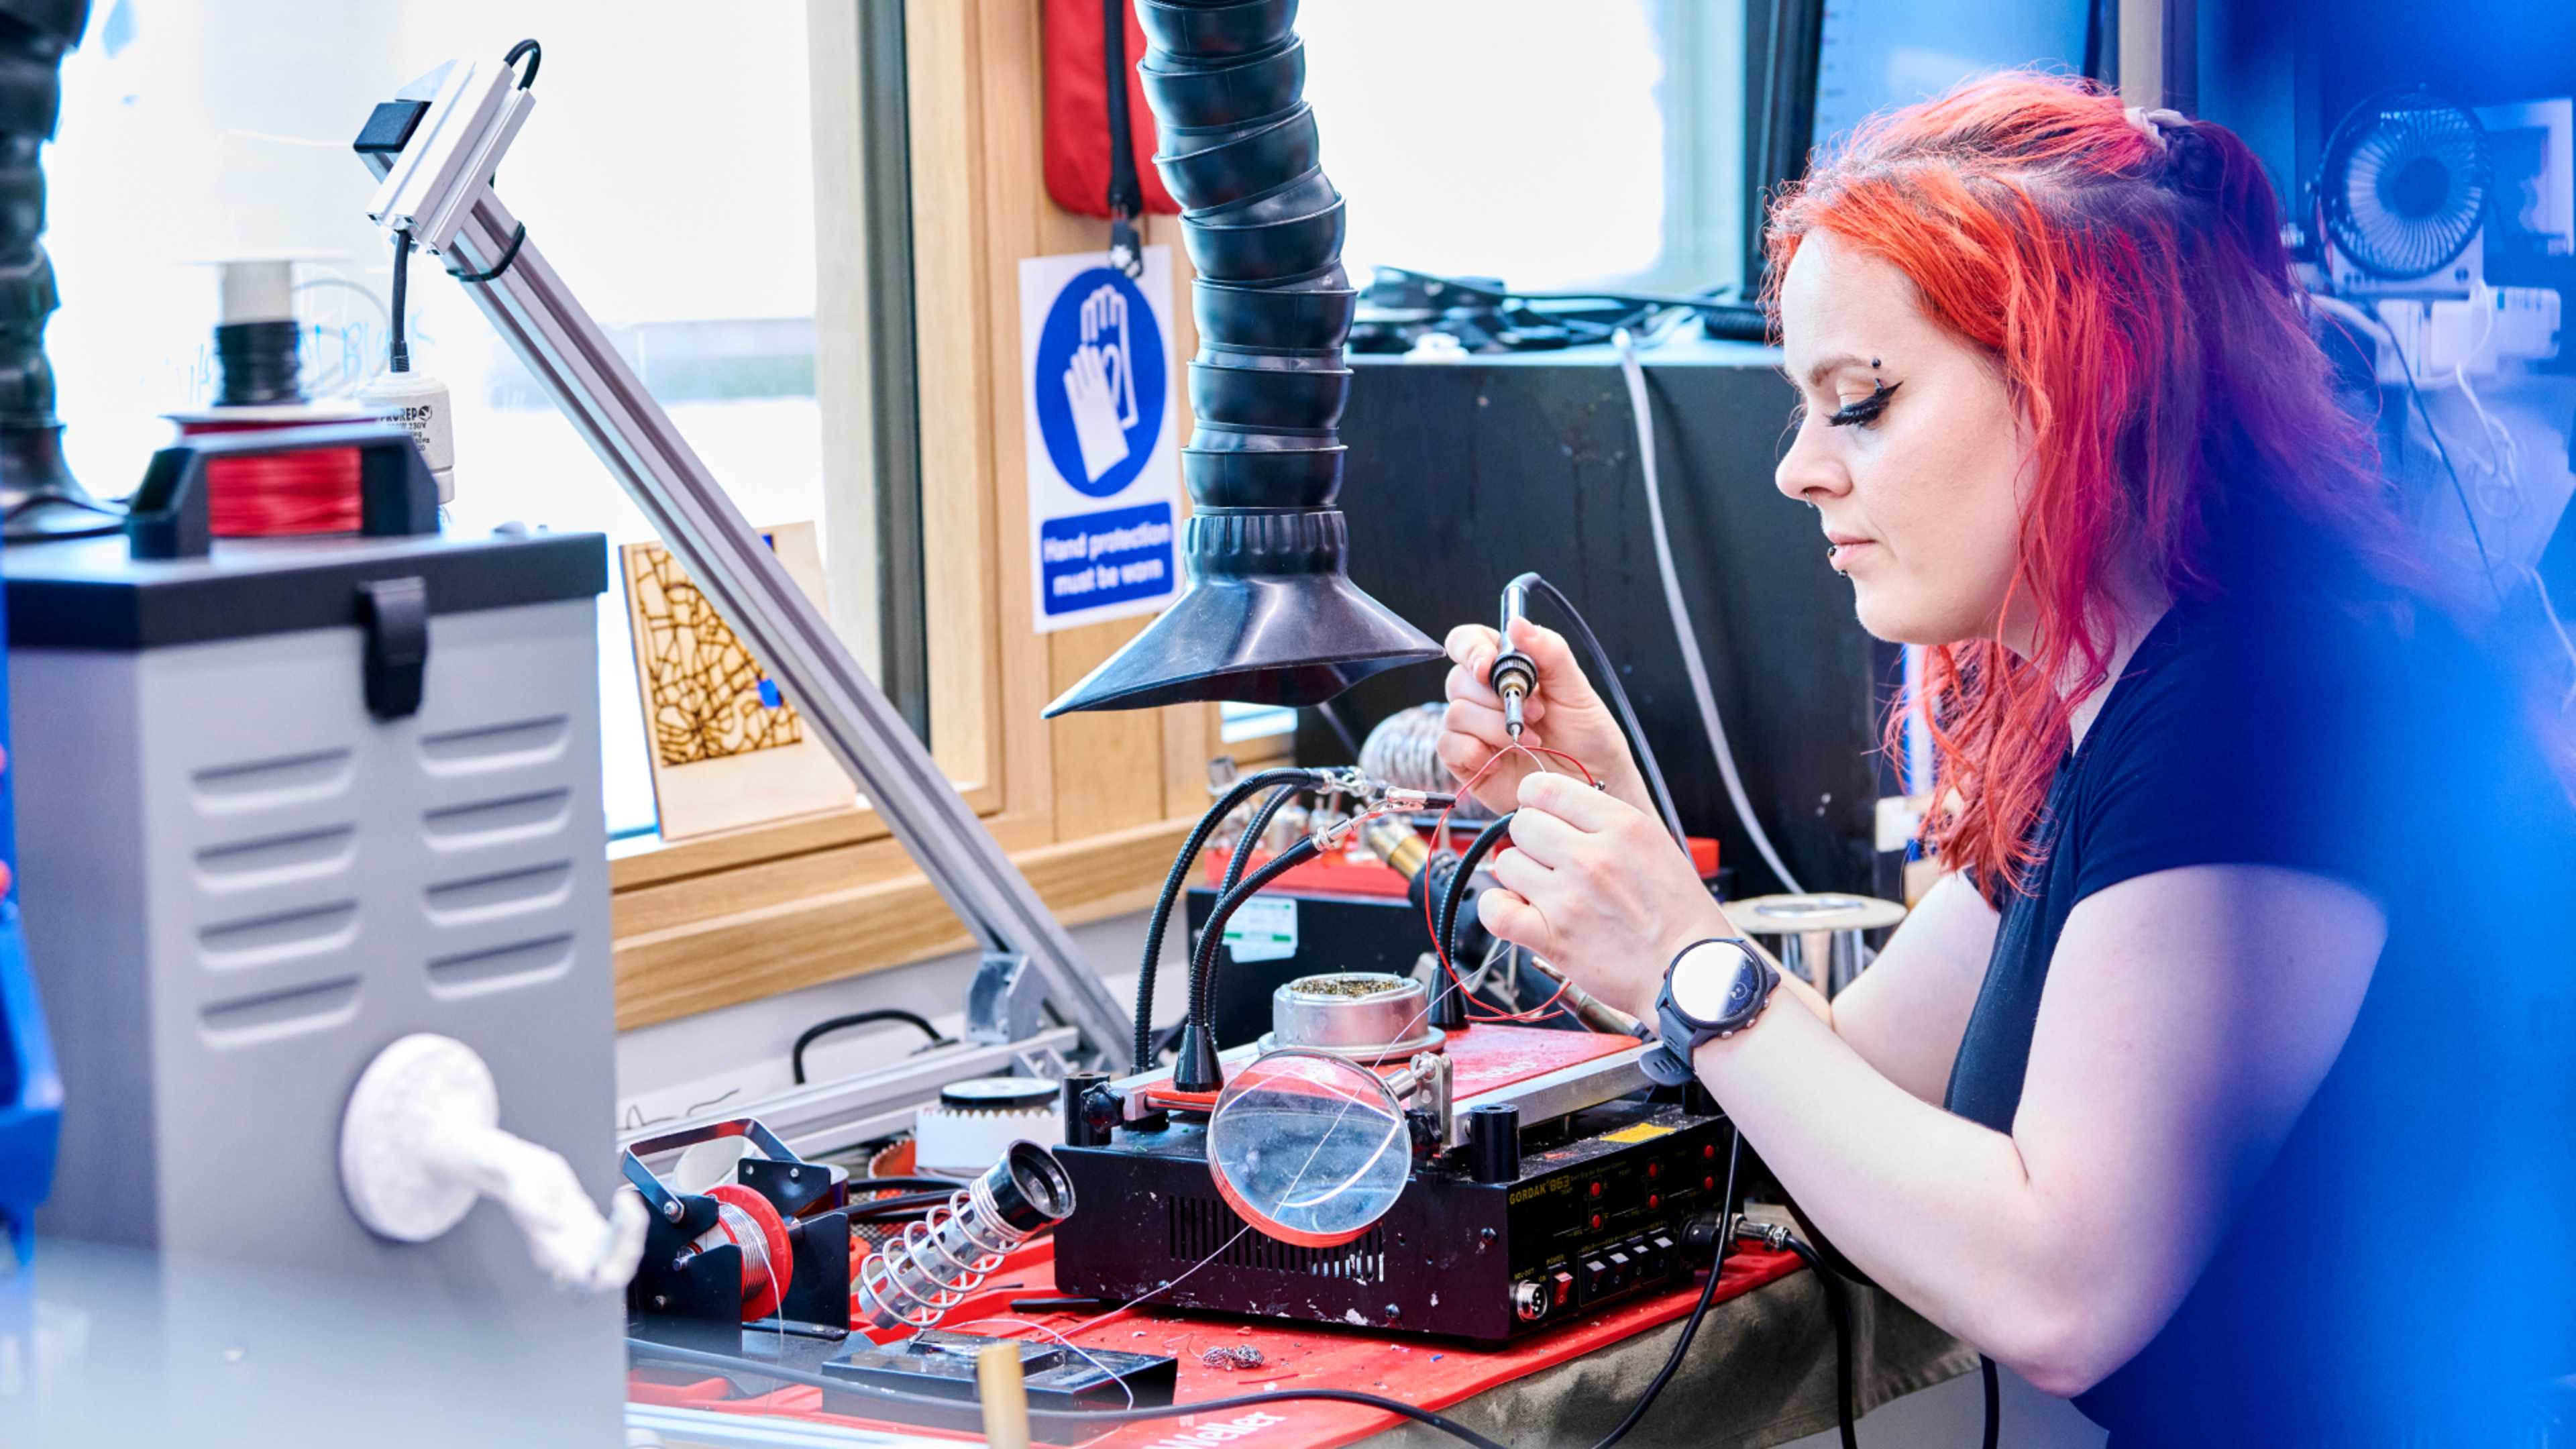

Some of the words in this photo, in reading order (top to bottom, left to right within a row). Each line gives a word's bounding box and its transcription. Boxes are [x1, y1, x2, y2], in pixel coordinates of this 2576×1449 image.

[1044, 532, 1087, 562] Hand
[1089, 521, 1171, 561] protection
[1053, 566, 1095, 596] must
[1096, 564, 1119, 590] be
[1120, 558, 1164, 585] worn
